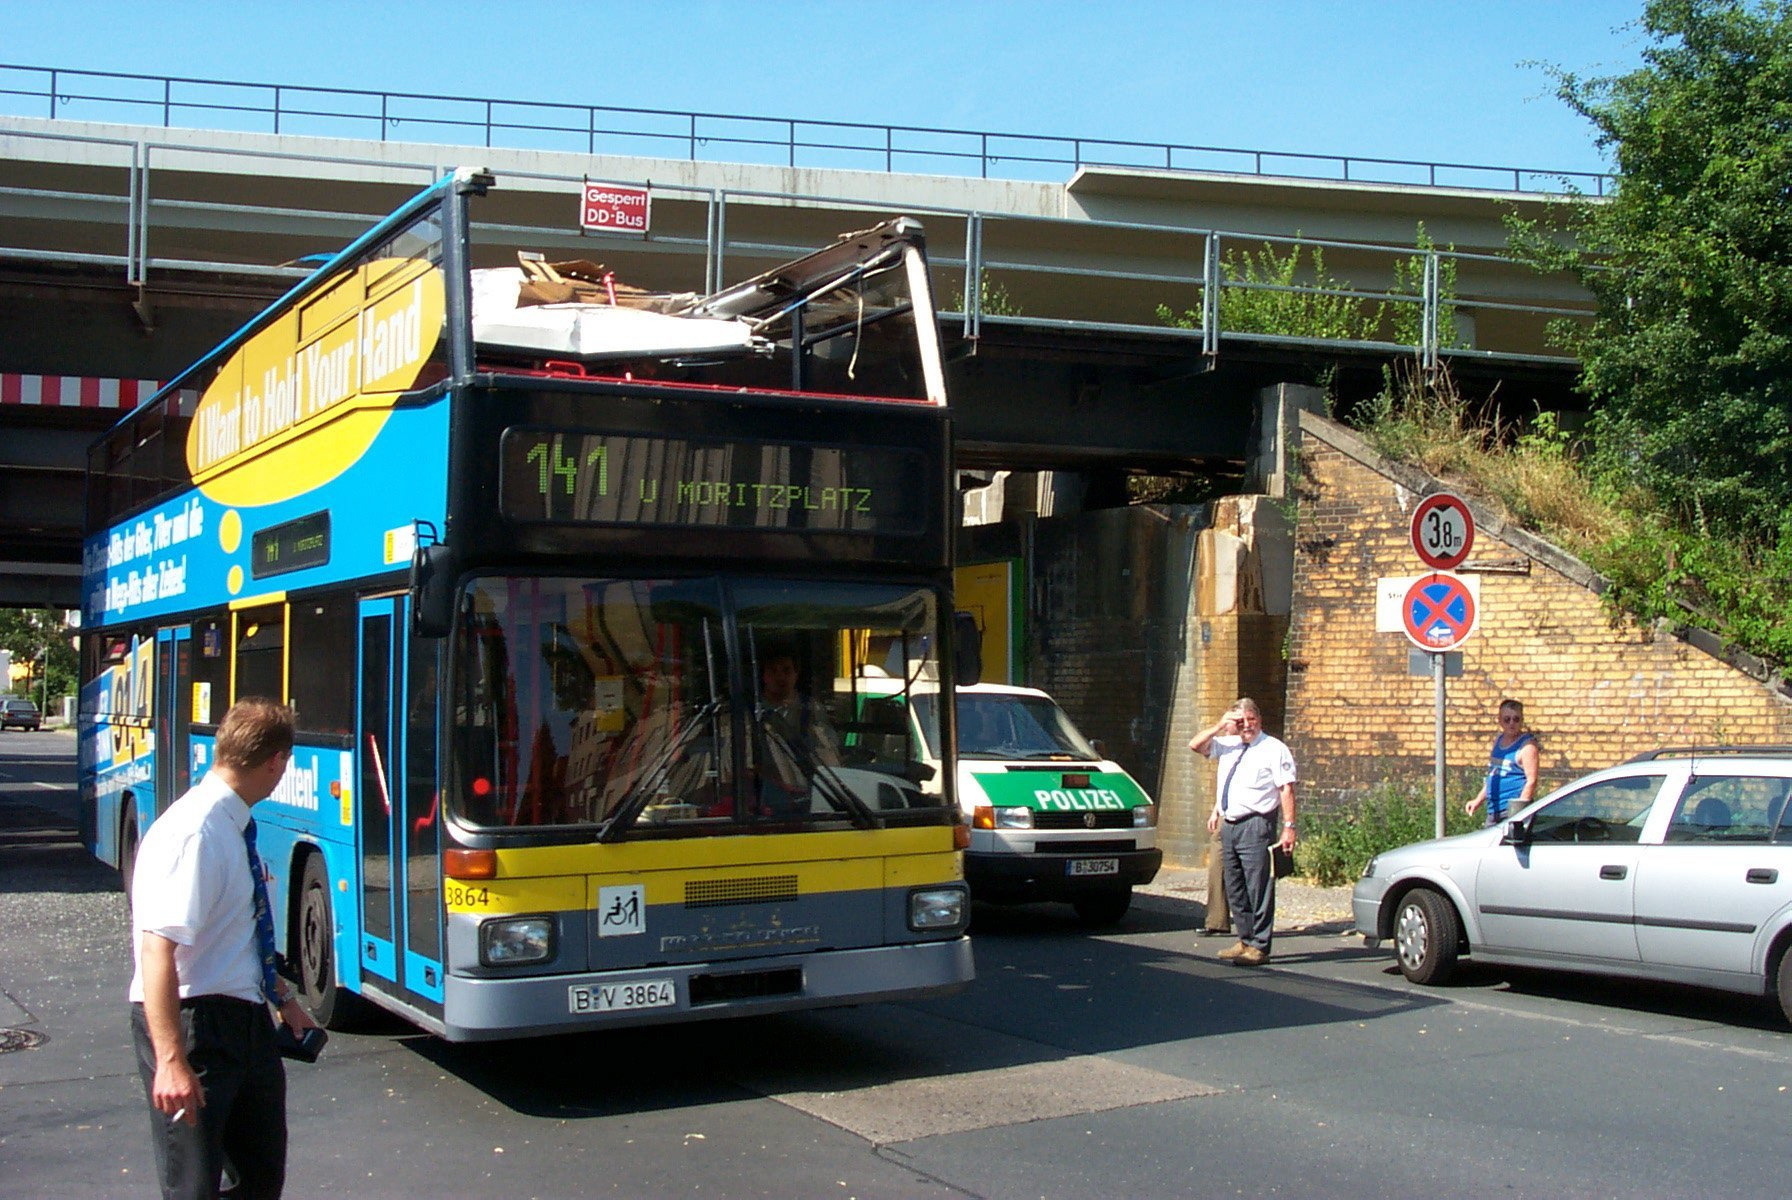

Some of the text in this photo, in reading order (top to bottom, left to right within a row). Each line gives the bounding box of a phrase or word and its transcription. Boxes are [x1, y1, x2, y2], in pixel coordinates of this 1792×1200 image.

[587, 189, 645, 206] Gesperrt
[198, 275, 421, 468] I Want to Hold Your Hand
[527, 443, 607, 496] 141
[640, 479, 871, 511] U MORITZPLATZ
[1034, 789, 1125, 810] POLIZEI
[446, 887, 490, 906] 3864
[623, 984, 669, 1006] 3864
